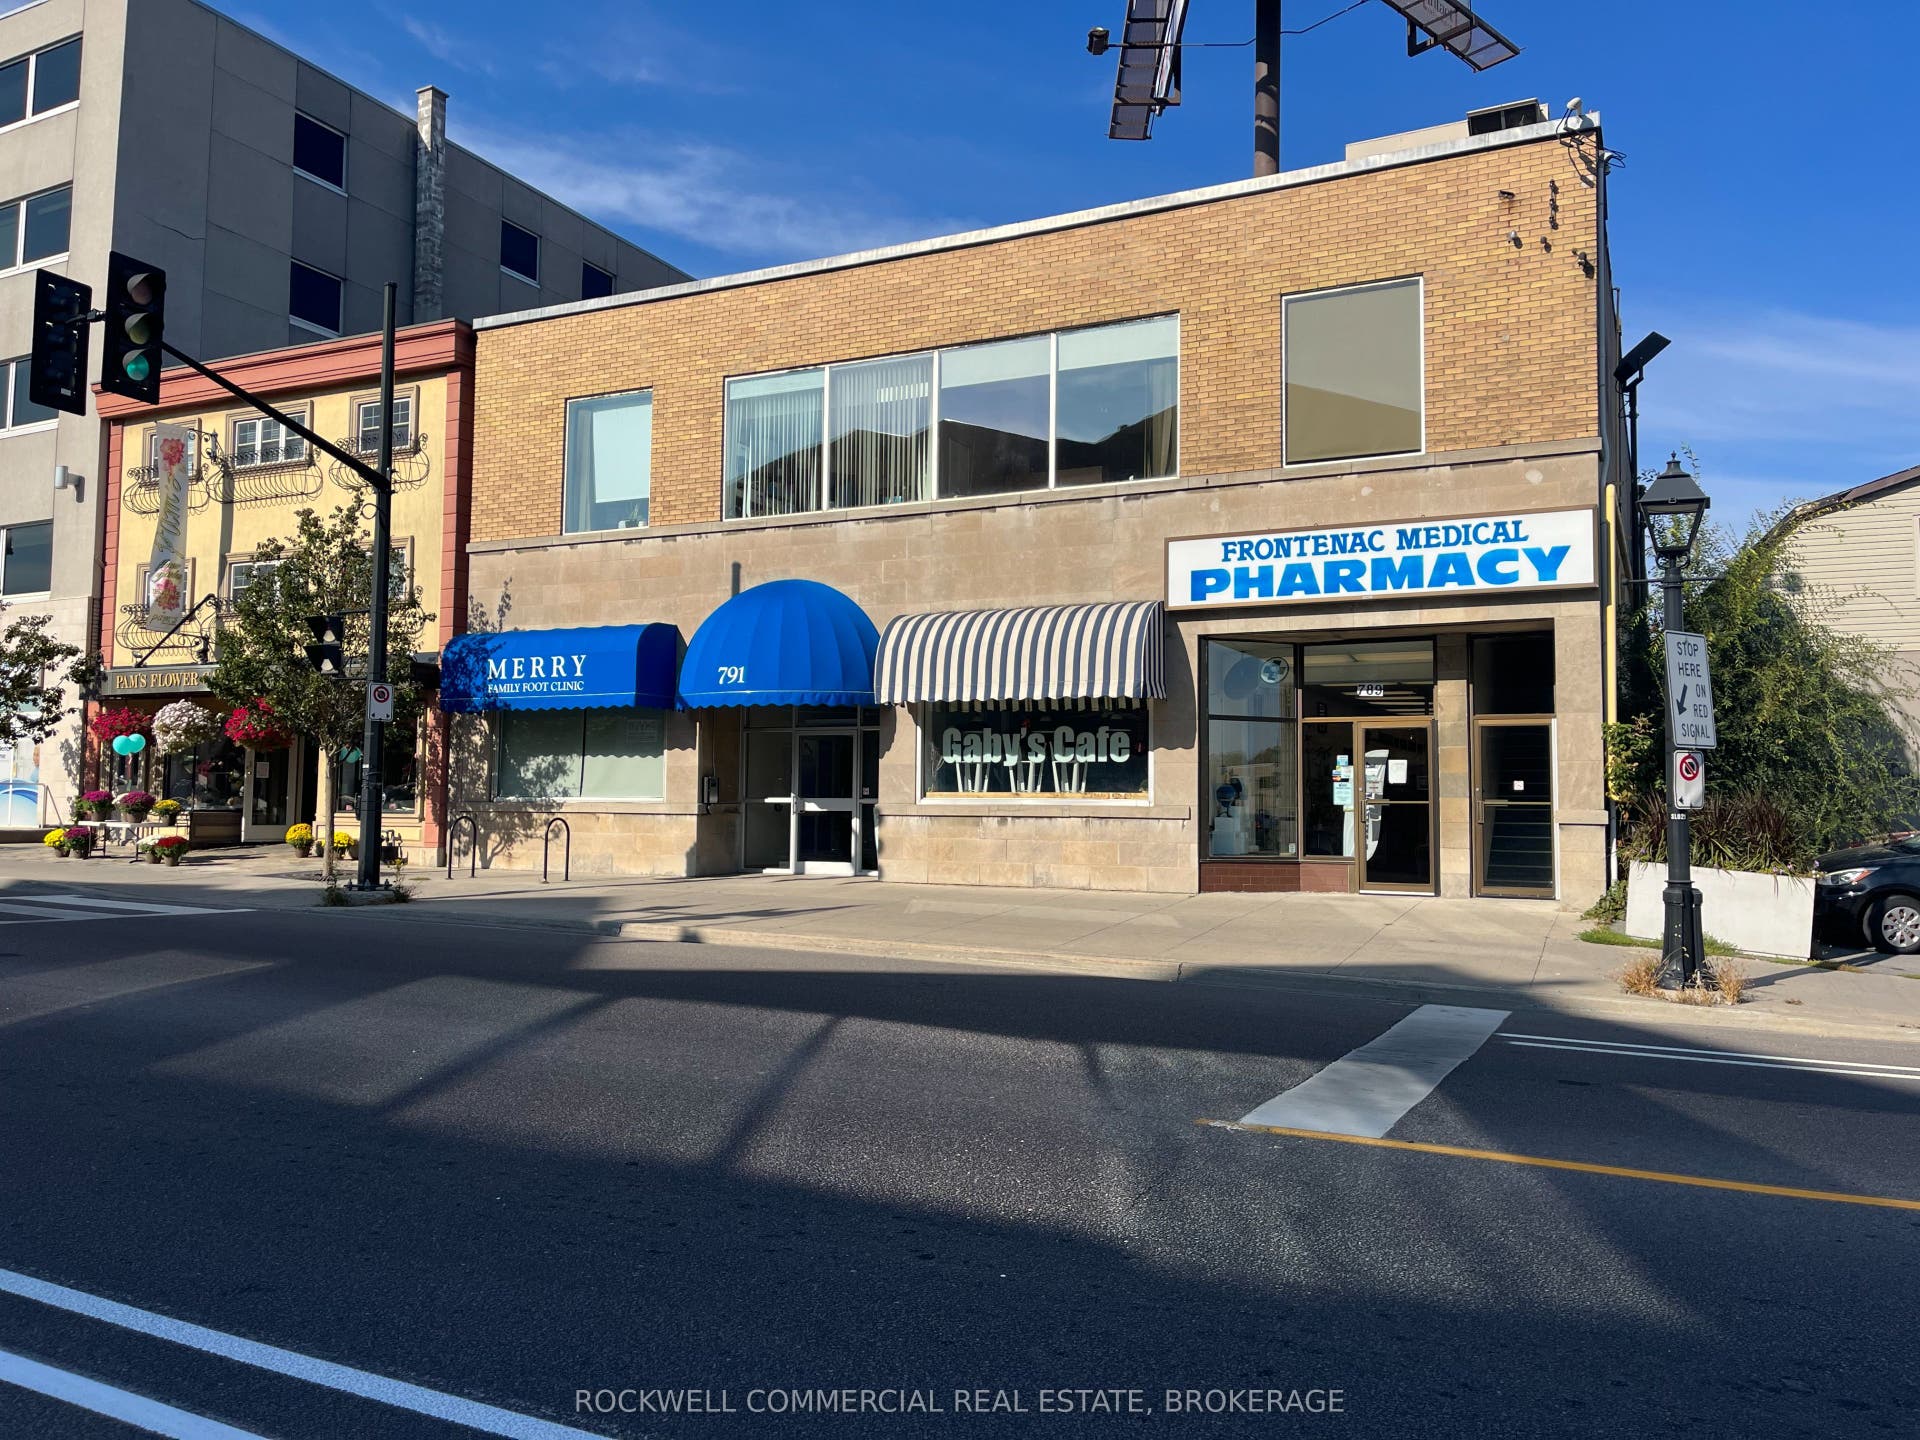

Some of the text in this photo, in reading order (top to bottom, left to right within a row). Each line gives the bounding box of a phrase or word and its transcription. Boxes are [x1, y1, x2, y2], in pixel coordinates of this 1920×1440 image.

[1222, 520, 1529, 562] FRONTENAC MEDICAL
[1191, 545, 1571, 601] PHARMACY
[1677, 641, 1699, 657] STOP
[487, 655, 586, 680] MERRY
[718, 666, 745, 685] 791
[1678, 662, 1702, 678] HERE
[116, 674, 147, 689] PAM'S
[150, 672, 199, 687] FLOWER
[487, 681, 585, 694] FAMILY FOOT CLINIC
[1358, 684, 1383, 695] 789
[1695, 684, 1706, 698] ON
[1693, 704, 1708, 718] RED
[1681, 723, 1710, 739] SIGNAL
[942, 725, 1130, 767] Gaby's Cafe
